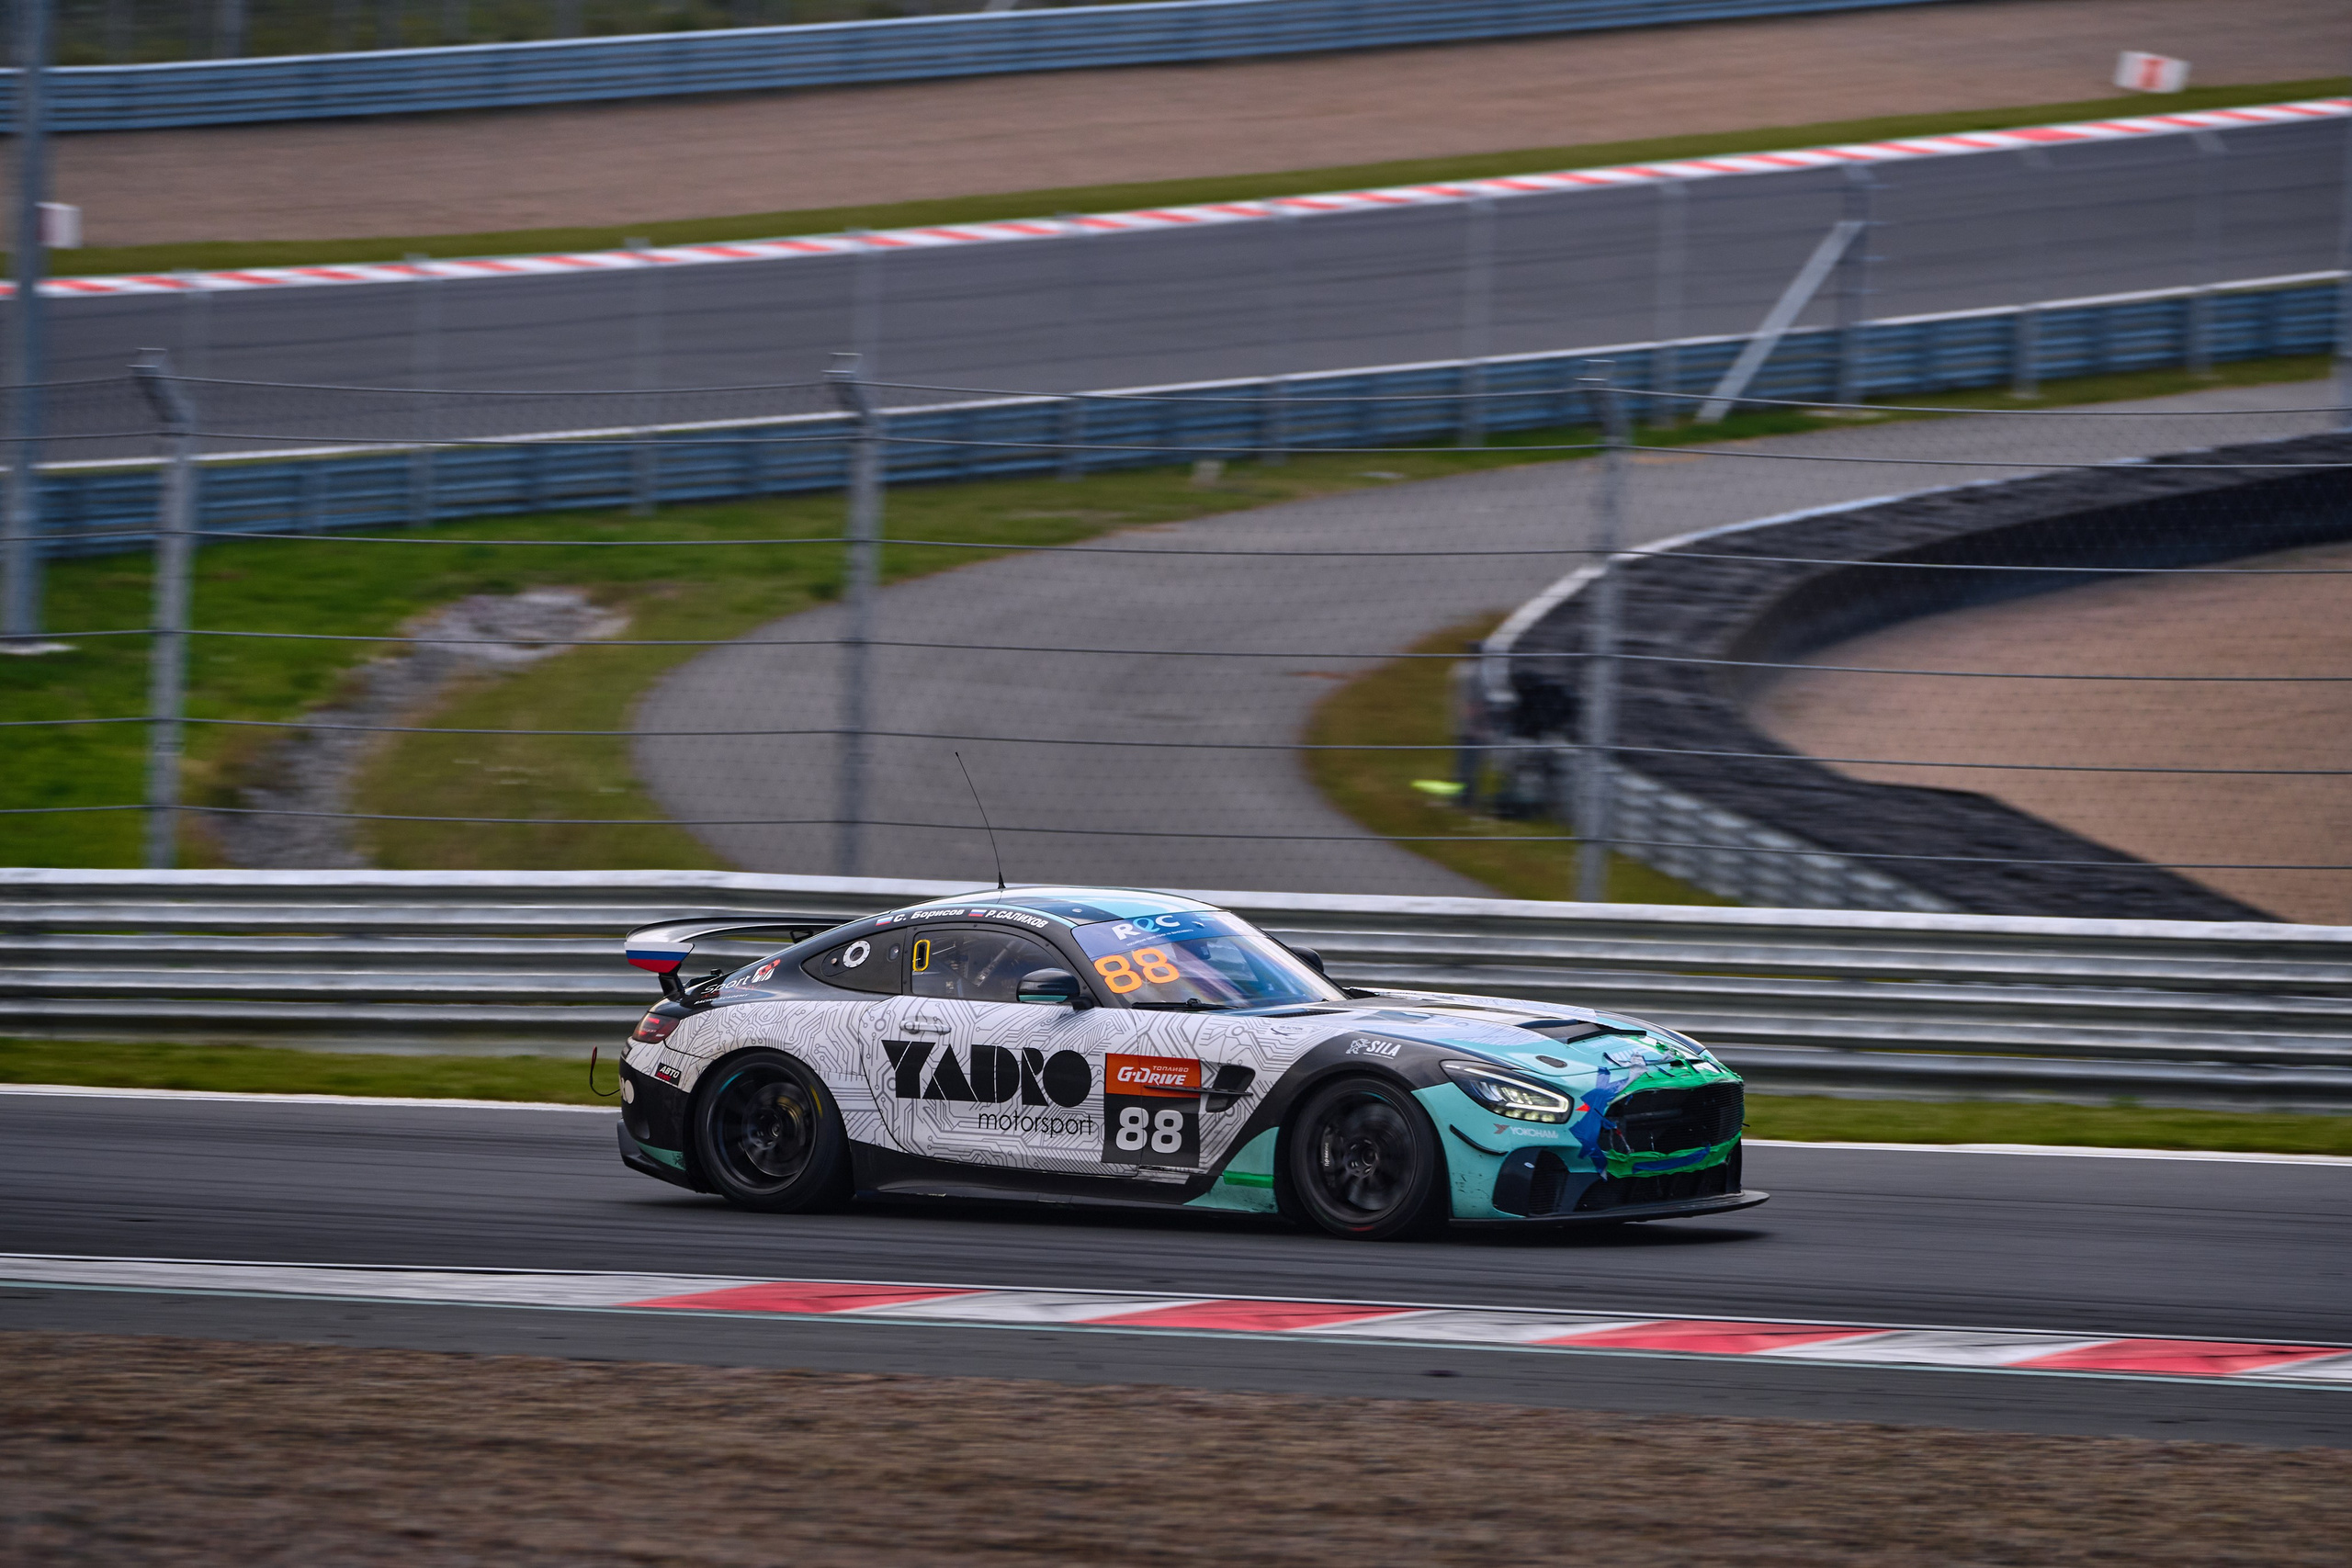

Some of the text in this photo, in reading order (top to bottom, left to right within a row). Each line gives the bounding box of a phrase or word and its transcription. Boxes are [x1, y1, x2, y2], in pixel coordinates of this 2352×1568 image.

[910, 909, 965, 919] Борисов
[985, 909, 1049, 929] Р.САЛИХОВ
[1093, 948, 1181, 994] 88
[1366, 1040, 1402, 1057] SILA
[881, 1039, 1092, 1108] YADRO
[978, 1110, 1093, 1139] motorsport
[1115, 1106, 1184, 1154] 88
